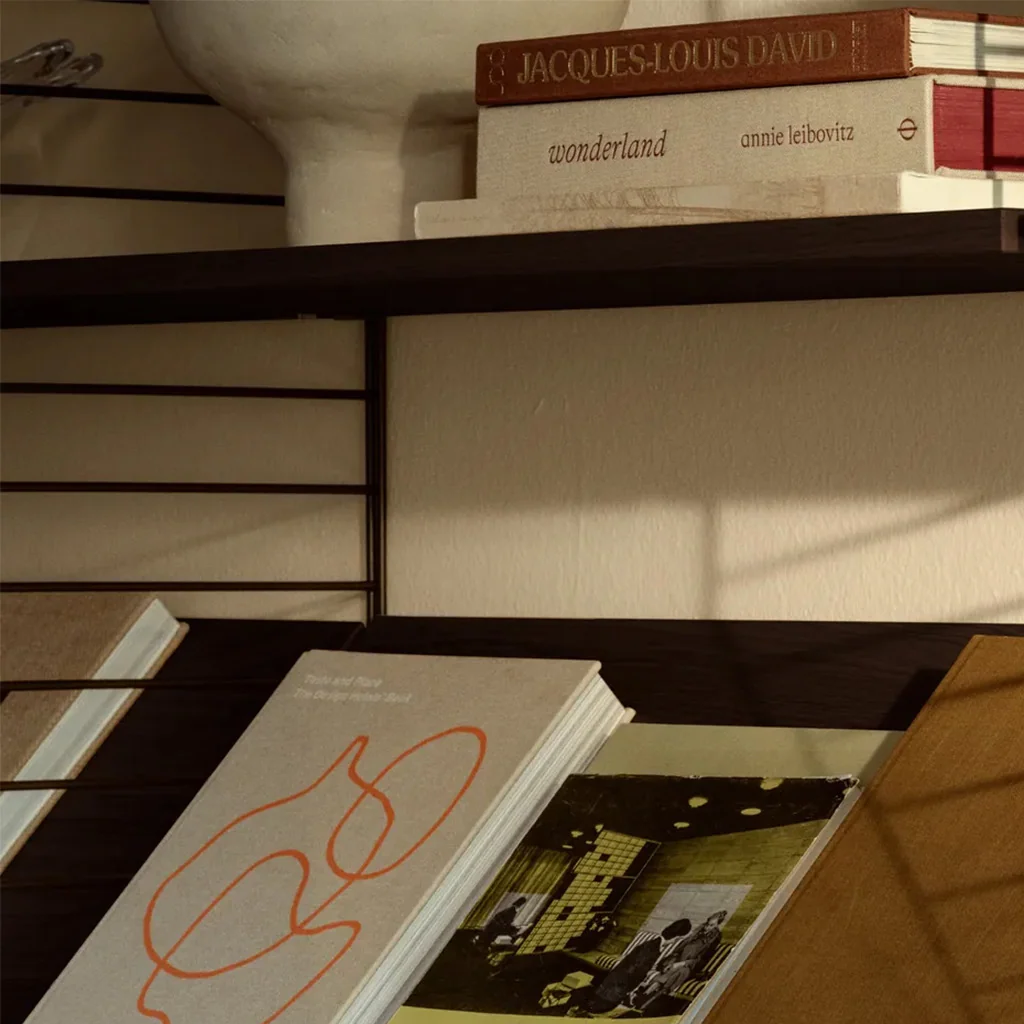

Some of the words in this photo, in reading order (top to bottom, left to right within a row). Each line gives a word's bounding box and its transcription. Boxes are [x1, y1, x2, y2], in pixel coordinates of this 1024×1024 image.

[517, 34, 740, 85] JACQUES-LOUIS
[746, 29, 838, 69] DAVID
[547, 129, 668, 165] wonderland
[739, 126, 784, 149] annie
[787, 122, 855, 147] leibovitz
